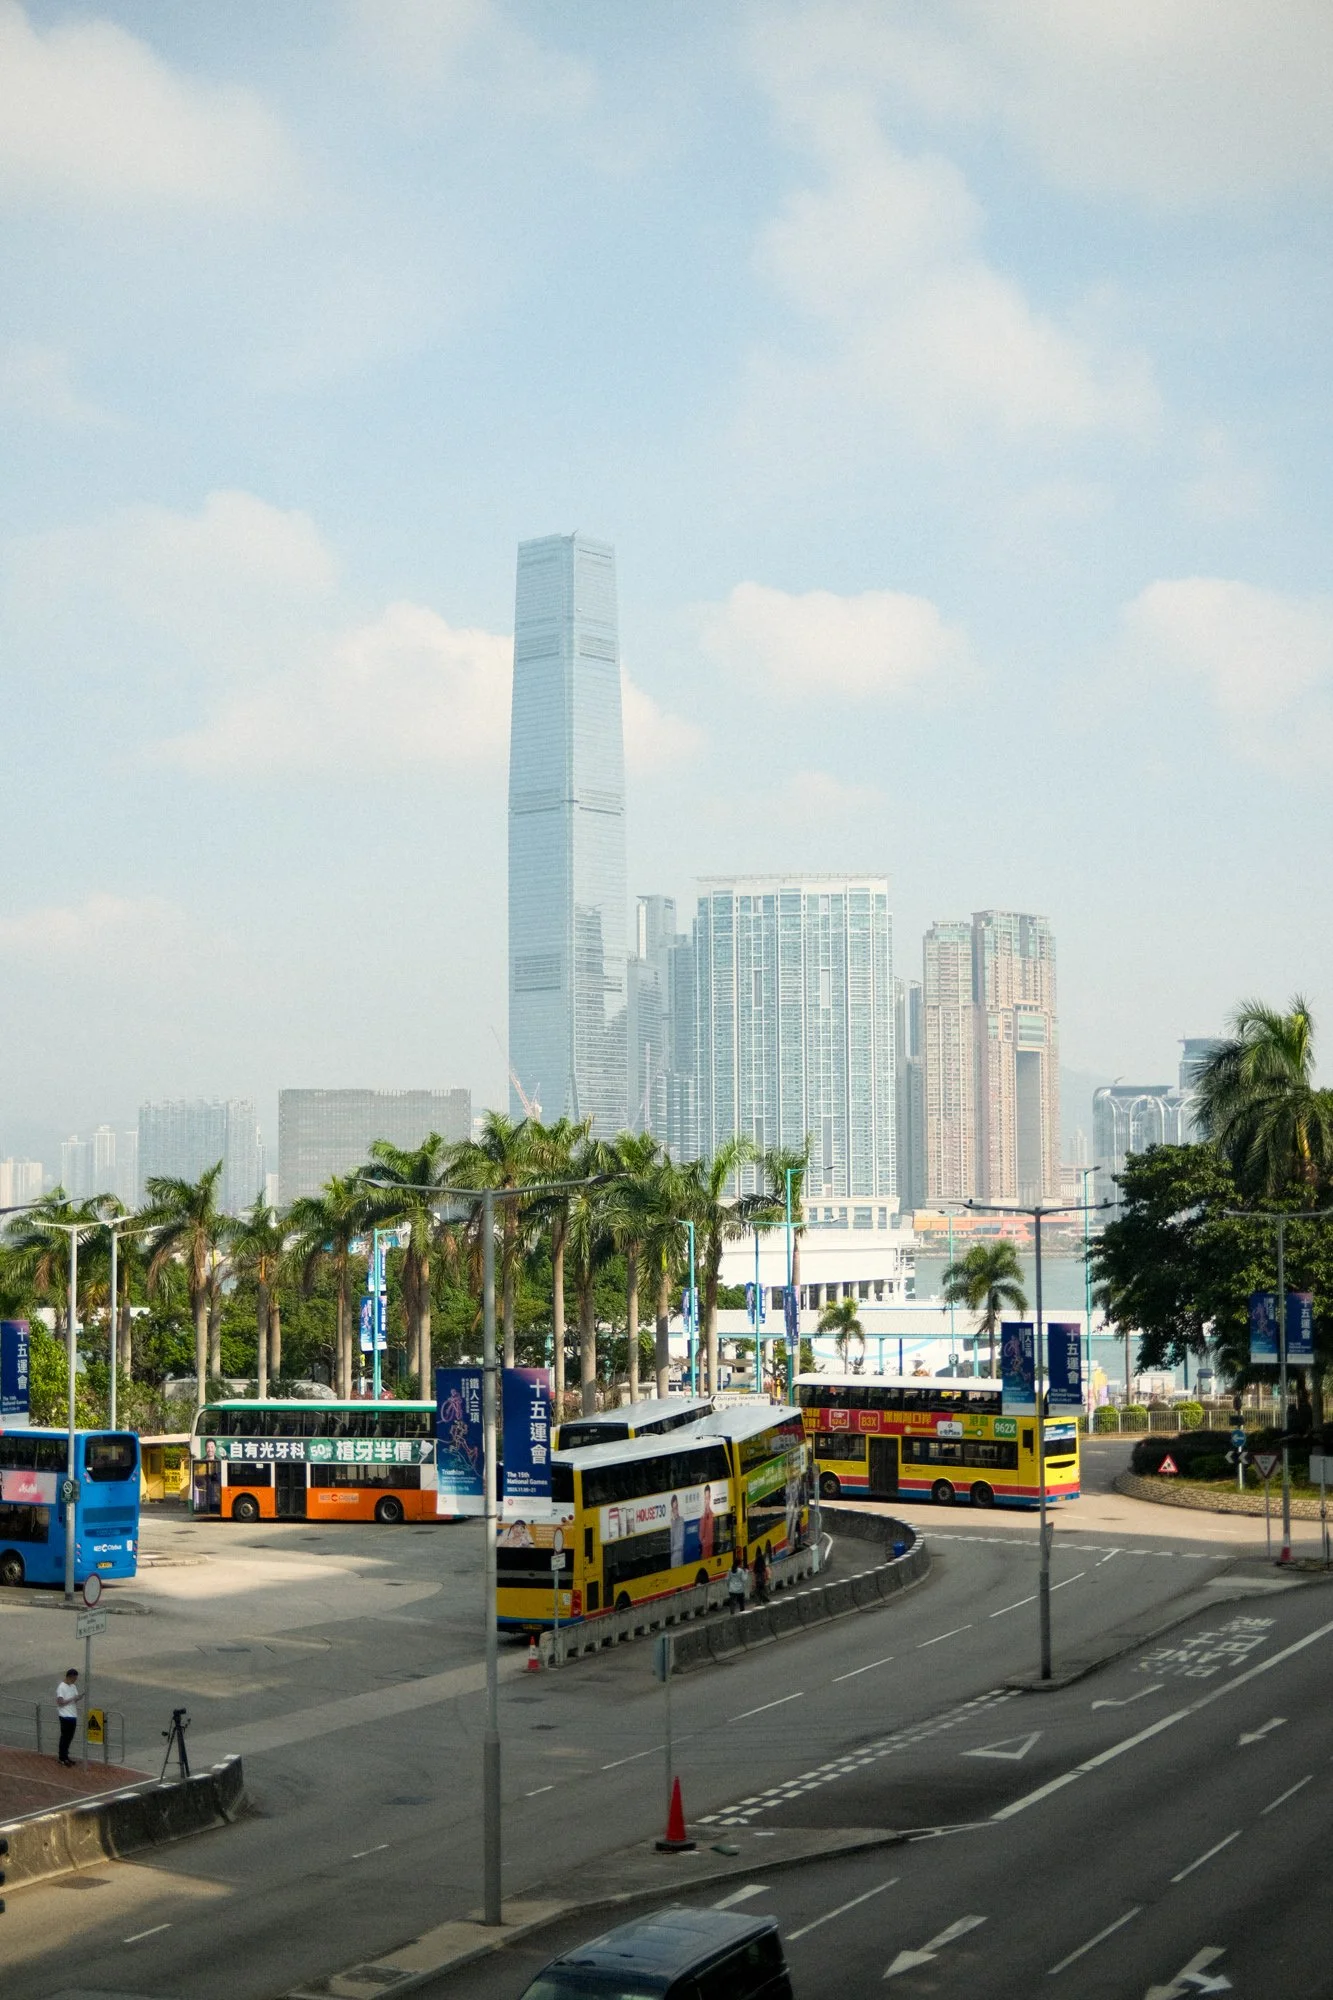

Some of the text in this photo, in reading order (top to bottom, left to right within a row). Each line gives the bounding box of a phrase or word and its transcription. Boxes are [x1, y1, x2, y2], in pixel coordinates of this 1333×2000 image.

[17, 1327, 28, 1390] 十五運會
[1066, 1328, 1079, 1385] 十五運會
[469, 1378, 480, 1423] 鐵人三項
[529, 1378, 548, 1465] 十五運會
[995, 1422, 1016, 1435] 962X
[230, 1441, 305, 1459] 自有光牙科
[336, 1440, 412, 1461] 植牙半價
[636, 1503, 666, 1523] HOUSE730
[1141, 1648, 1250, 1667] LANE
[1130, 1661, 1222, 1678] BUS
